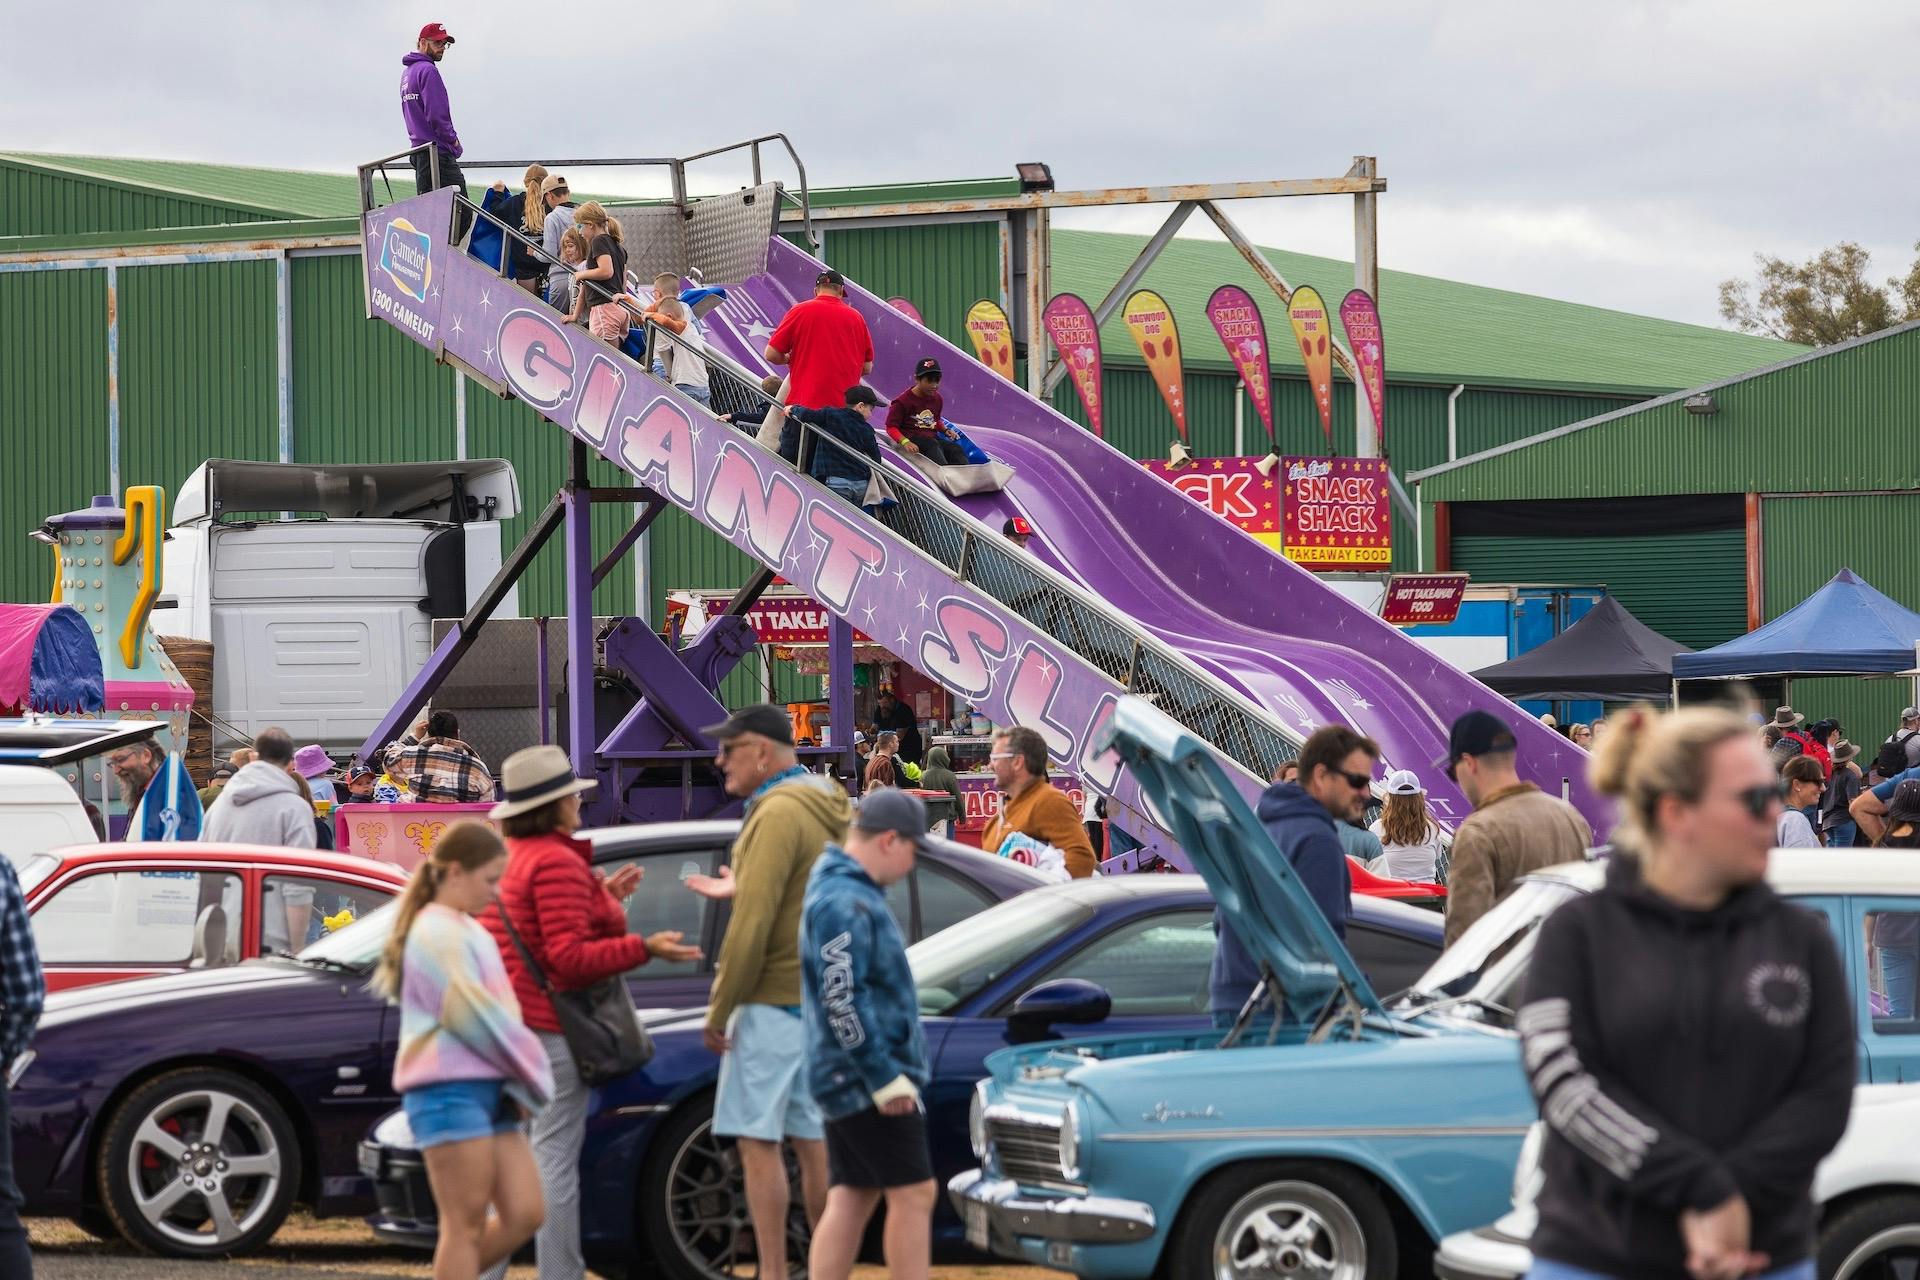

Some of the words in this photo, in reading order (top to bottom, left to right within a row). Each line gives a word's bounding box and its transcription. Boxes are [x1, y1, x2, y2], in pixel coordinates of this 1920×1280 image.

[390, 232, 425, 272] Camelot
[371, 287, 392, 313] 1300
[393, 301, 435, 341] CAMELOT
[1050, 314, 1087, 330] SNACK
[1214, 307, 1252, 323] SNACK
[1346, 312, 1374, 325] SNACK
[1057, 329, 1094, 345] SHACK
[1144, 324, 1161, 335] DOG
[1222, 322, 1259, 338] SHACK
[1350, 326, 1378, 340] SHACK
[496, 308, 888, 616] GIANT
[1297, 477, 1377, 504] SNACK
[1297, 504, 1378, 532] SHACK
[1288, 548, 1351, 560] TAKEAWAY
[1356, 549, 1388, 561] FOOD
[1396, 588, 1415, 600] HOT
[1414, 588, 1456, 600] TAKEAWAY
[1410, 601, 1434, 613] FOOD
